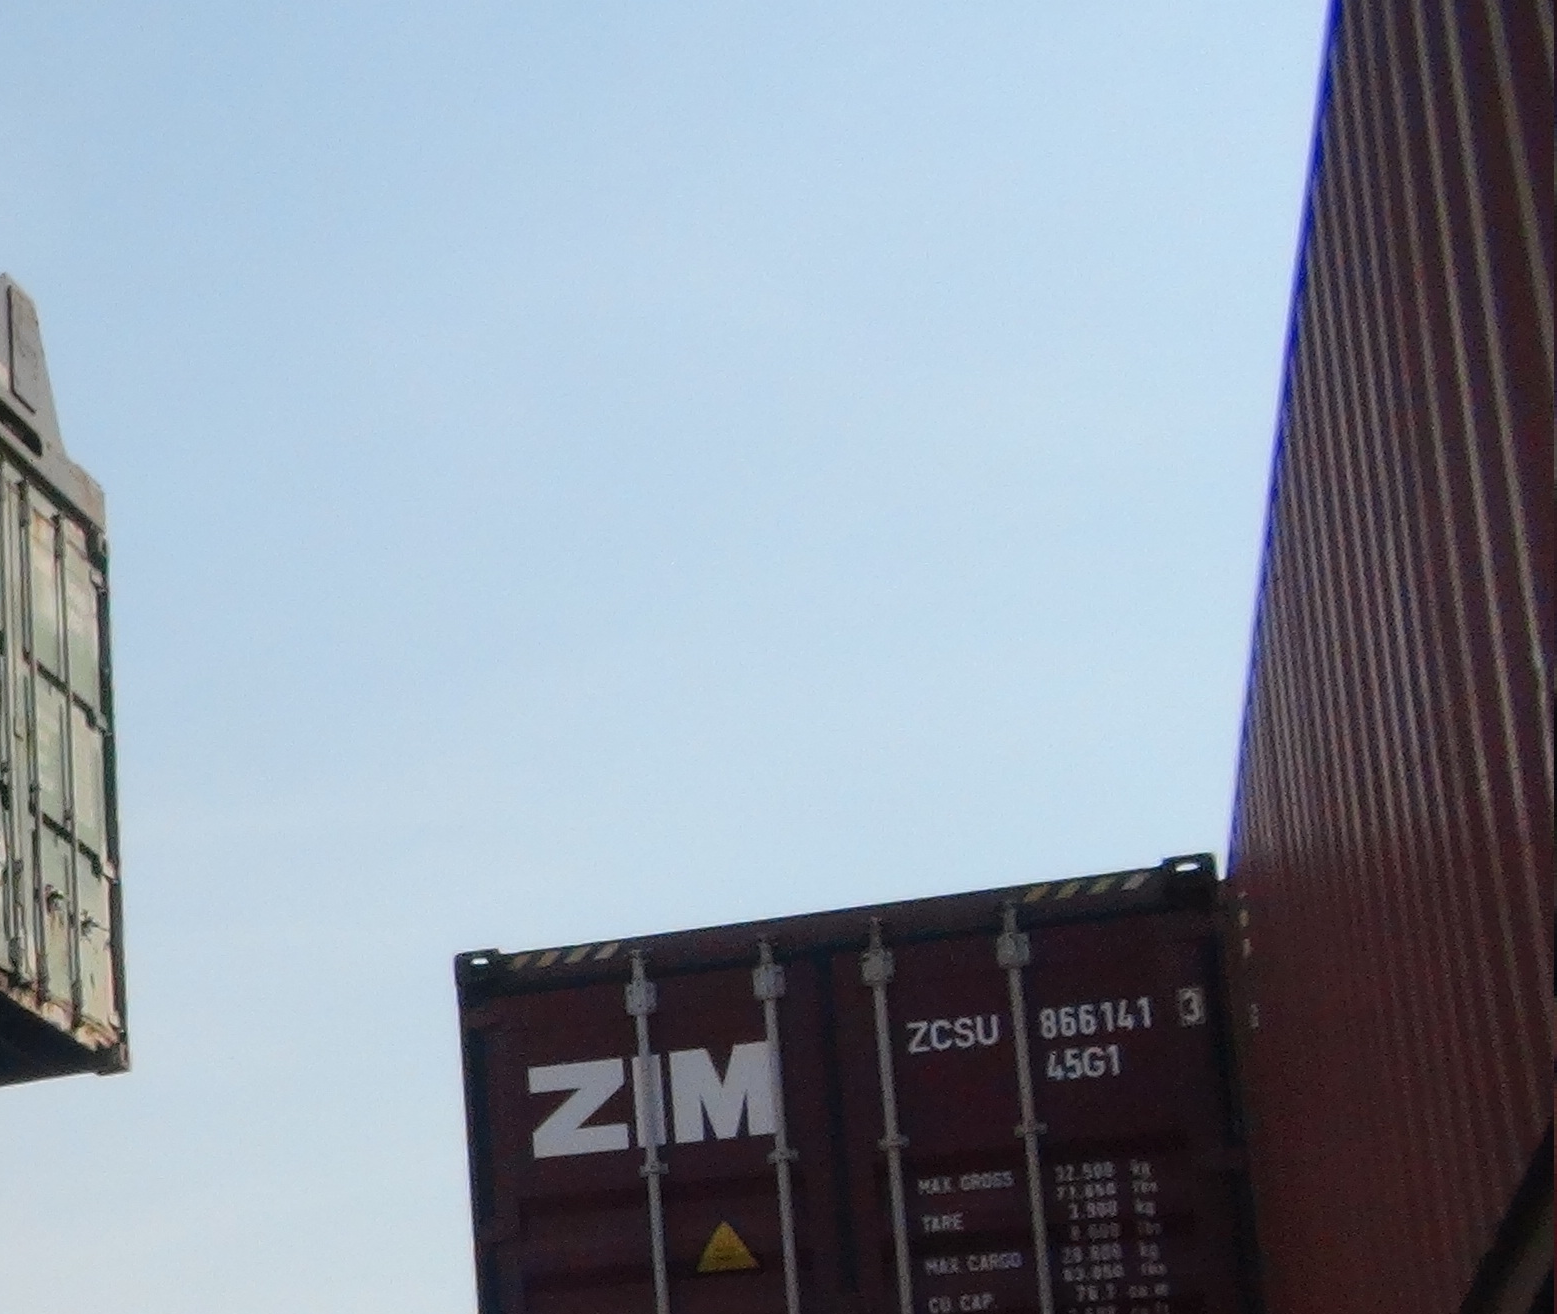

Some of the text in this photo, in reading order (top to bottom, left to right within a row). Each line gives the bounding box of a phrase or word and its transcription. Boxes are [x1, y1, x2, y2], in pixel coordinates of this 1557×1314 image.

[906, 987, 1204, 1055] ZCSU 866141 3
[1045, 1043, 1122, 1082] 45G1
[527, 1040, 783, 1160] ZIM
[922, 1211, 964, 1233] TARE
[966, 1251, 1024, 1273] CARGO
